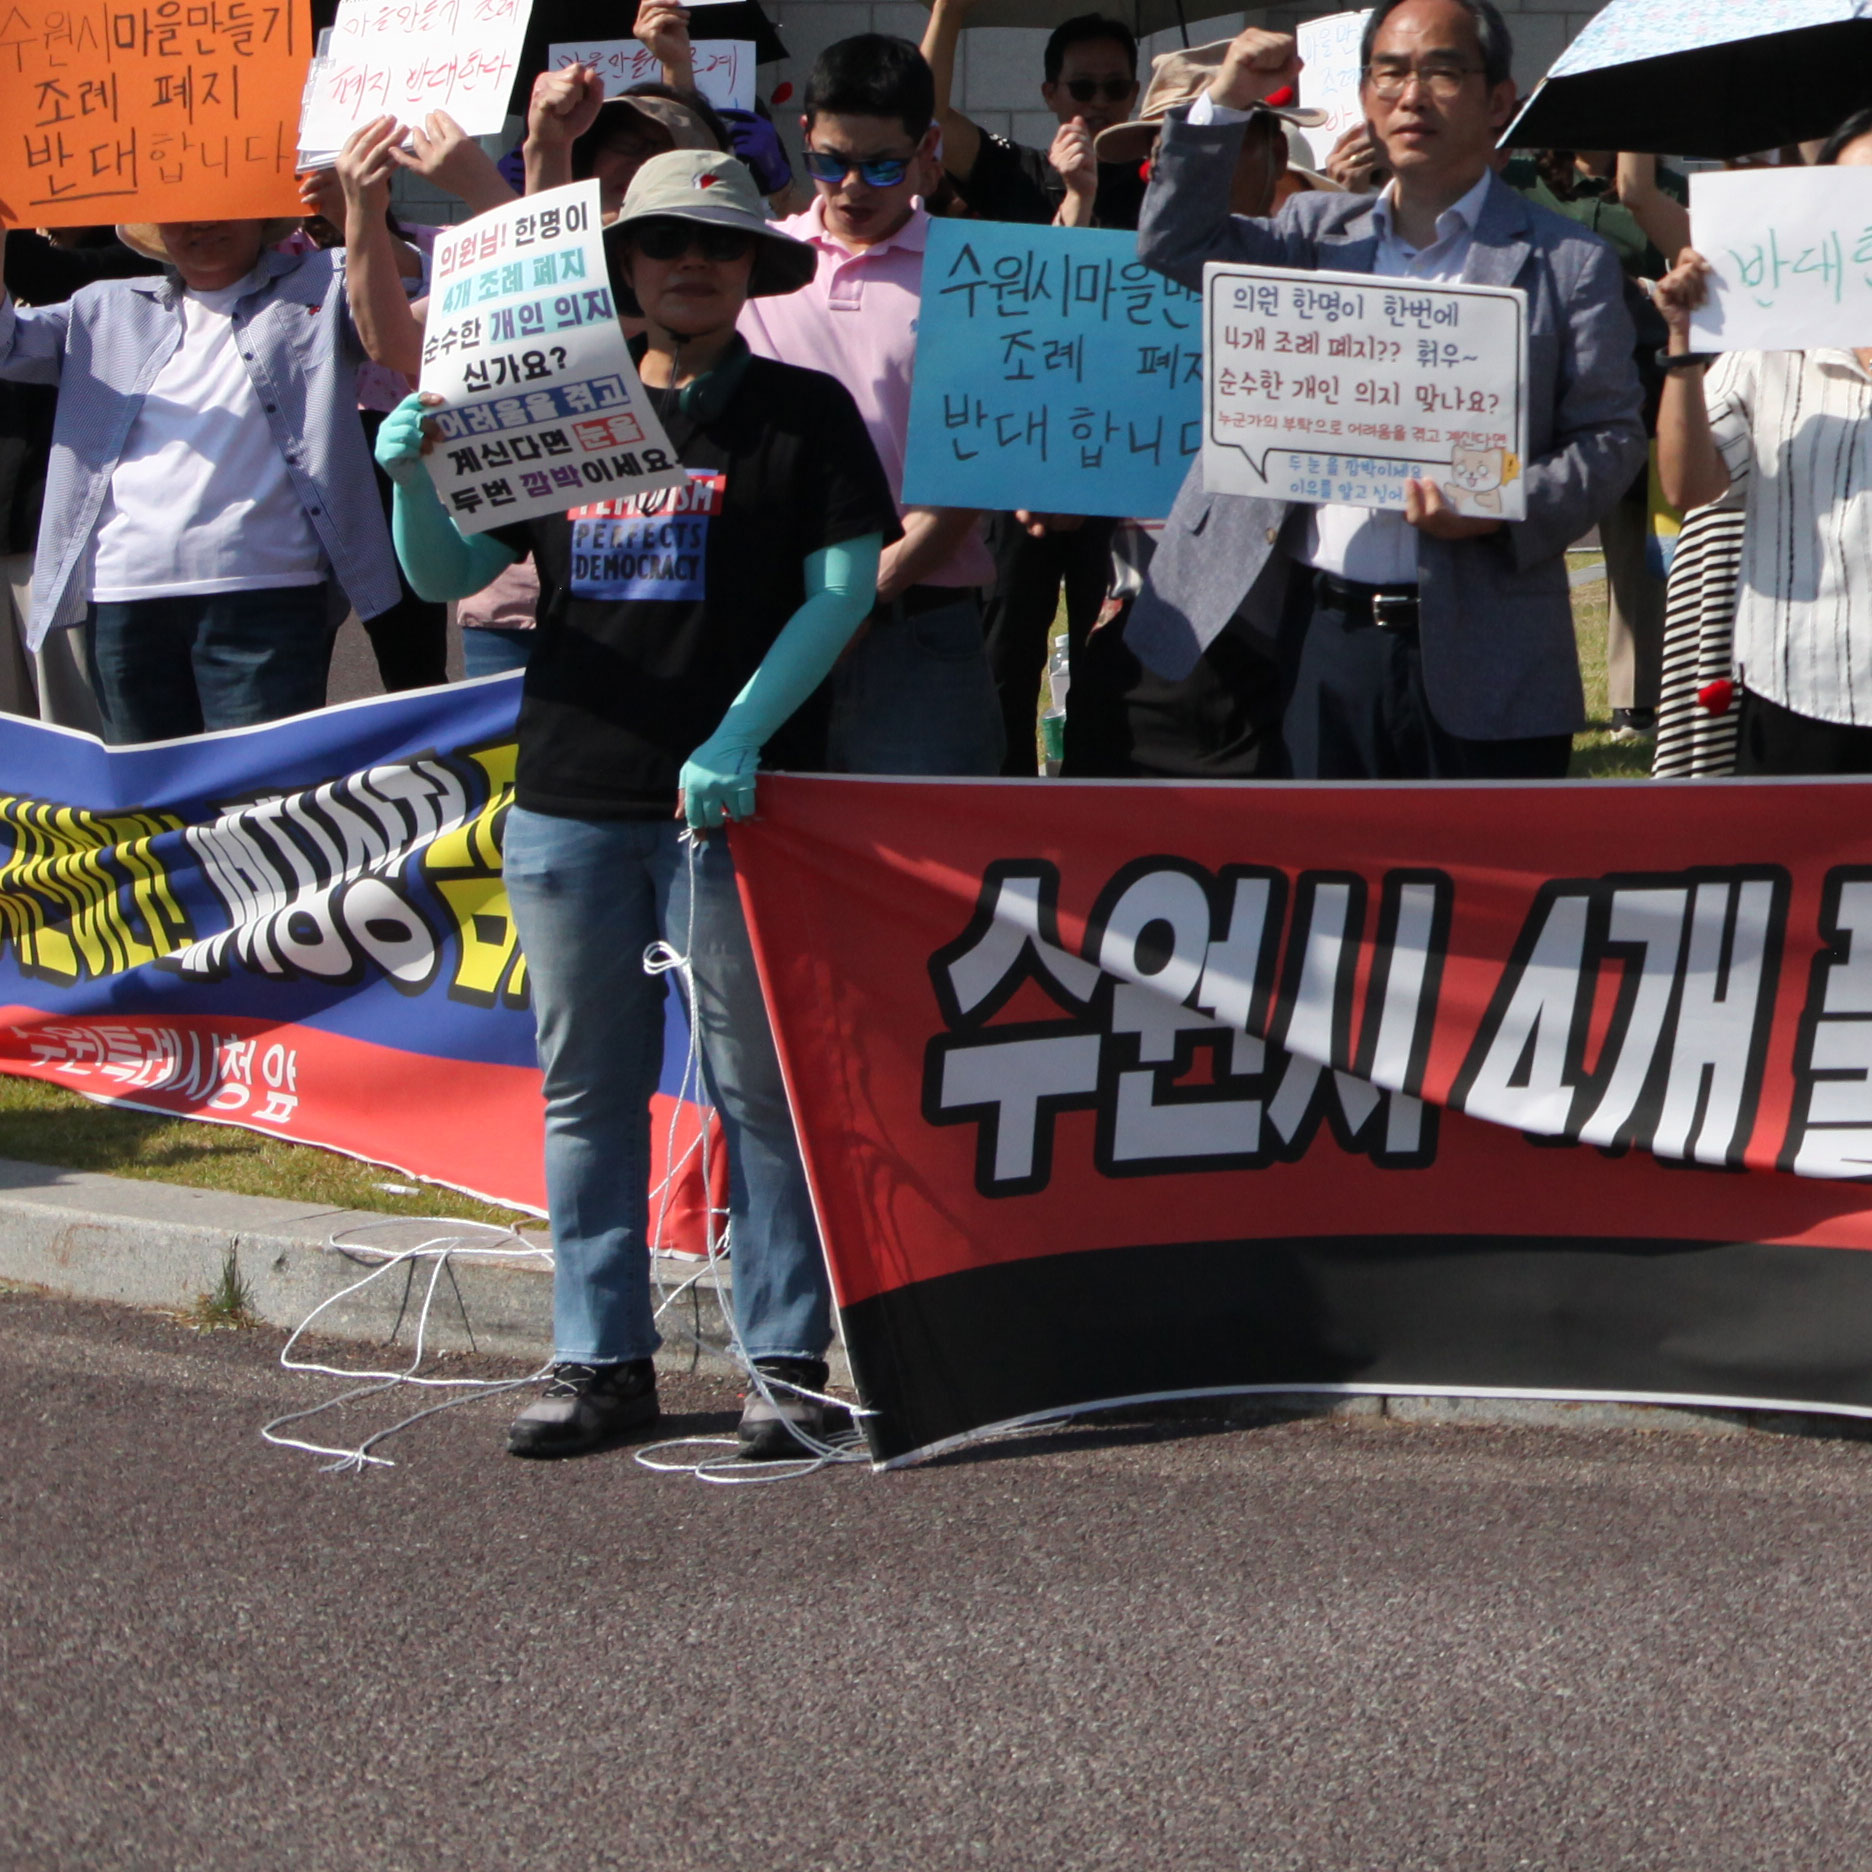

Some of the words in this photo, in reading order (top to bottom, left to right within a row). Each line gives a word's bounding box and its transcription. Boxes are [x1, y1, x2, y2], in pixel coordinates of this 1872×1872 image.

[35, 72, 117, 128] 조례
[150, 65, 238, 124] 폐지
[440, 224, 508, 278] 의원님!
[514, 206, 589, 249] 한명이
[442, 285, 471, 315] 4개
[478, 265, 524, 301] 조례
[533, 252, 586, 287] 폐지
[1234, 286, 1279, 316] 의원
[1293, 288, 1364, 322] 한명이
[1384, 296, 1459, 328] 한번에
[423, 321, 482, 365] 순수한
[491, 303, 544, 340] 개인
[557, 288, 613, 327] 의지
[1225, 327, 1264, 351] 4개
[1274, 331, 1319, 355] 조례
[1328, 334, 1401, 362] 폐지??
[463, 347, 568, 394] 신가요?
[1001, 330, 1087, 383] 조례
[440, 395, 558, 439] 어려움을
[563, 377, 630, 410] 겪고
[1219, 368, 1283, 399] 순수한
[1293, 375, 1339, 405] 개인
[1355, 381, 1400, 405] 의지
[1416, 384, 1499, 414] 맞나요?
[448, 430, 570, 475] 계신다면
[577, 416, 641, 450] 눈을
[576, 524, 700, 549] PERFECTS
[576, 555, 699, 580] DEMOCRACY
[939, 872, 1451, 1183] 수원시
[1465, 878, 1777, 1165] 4개
